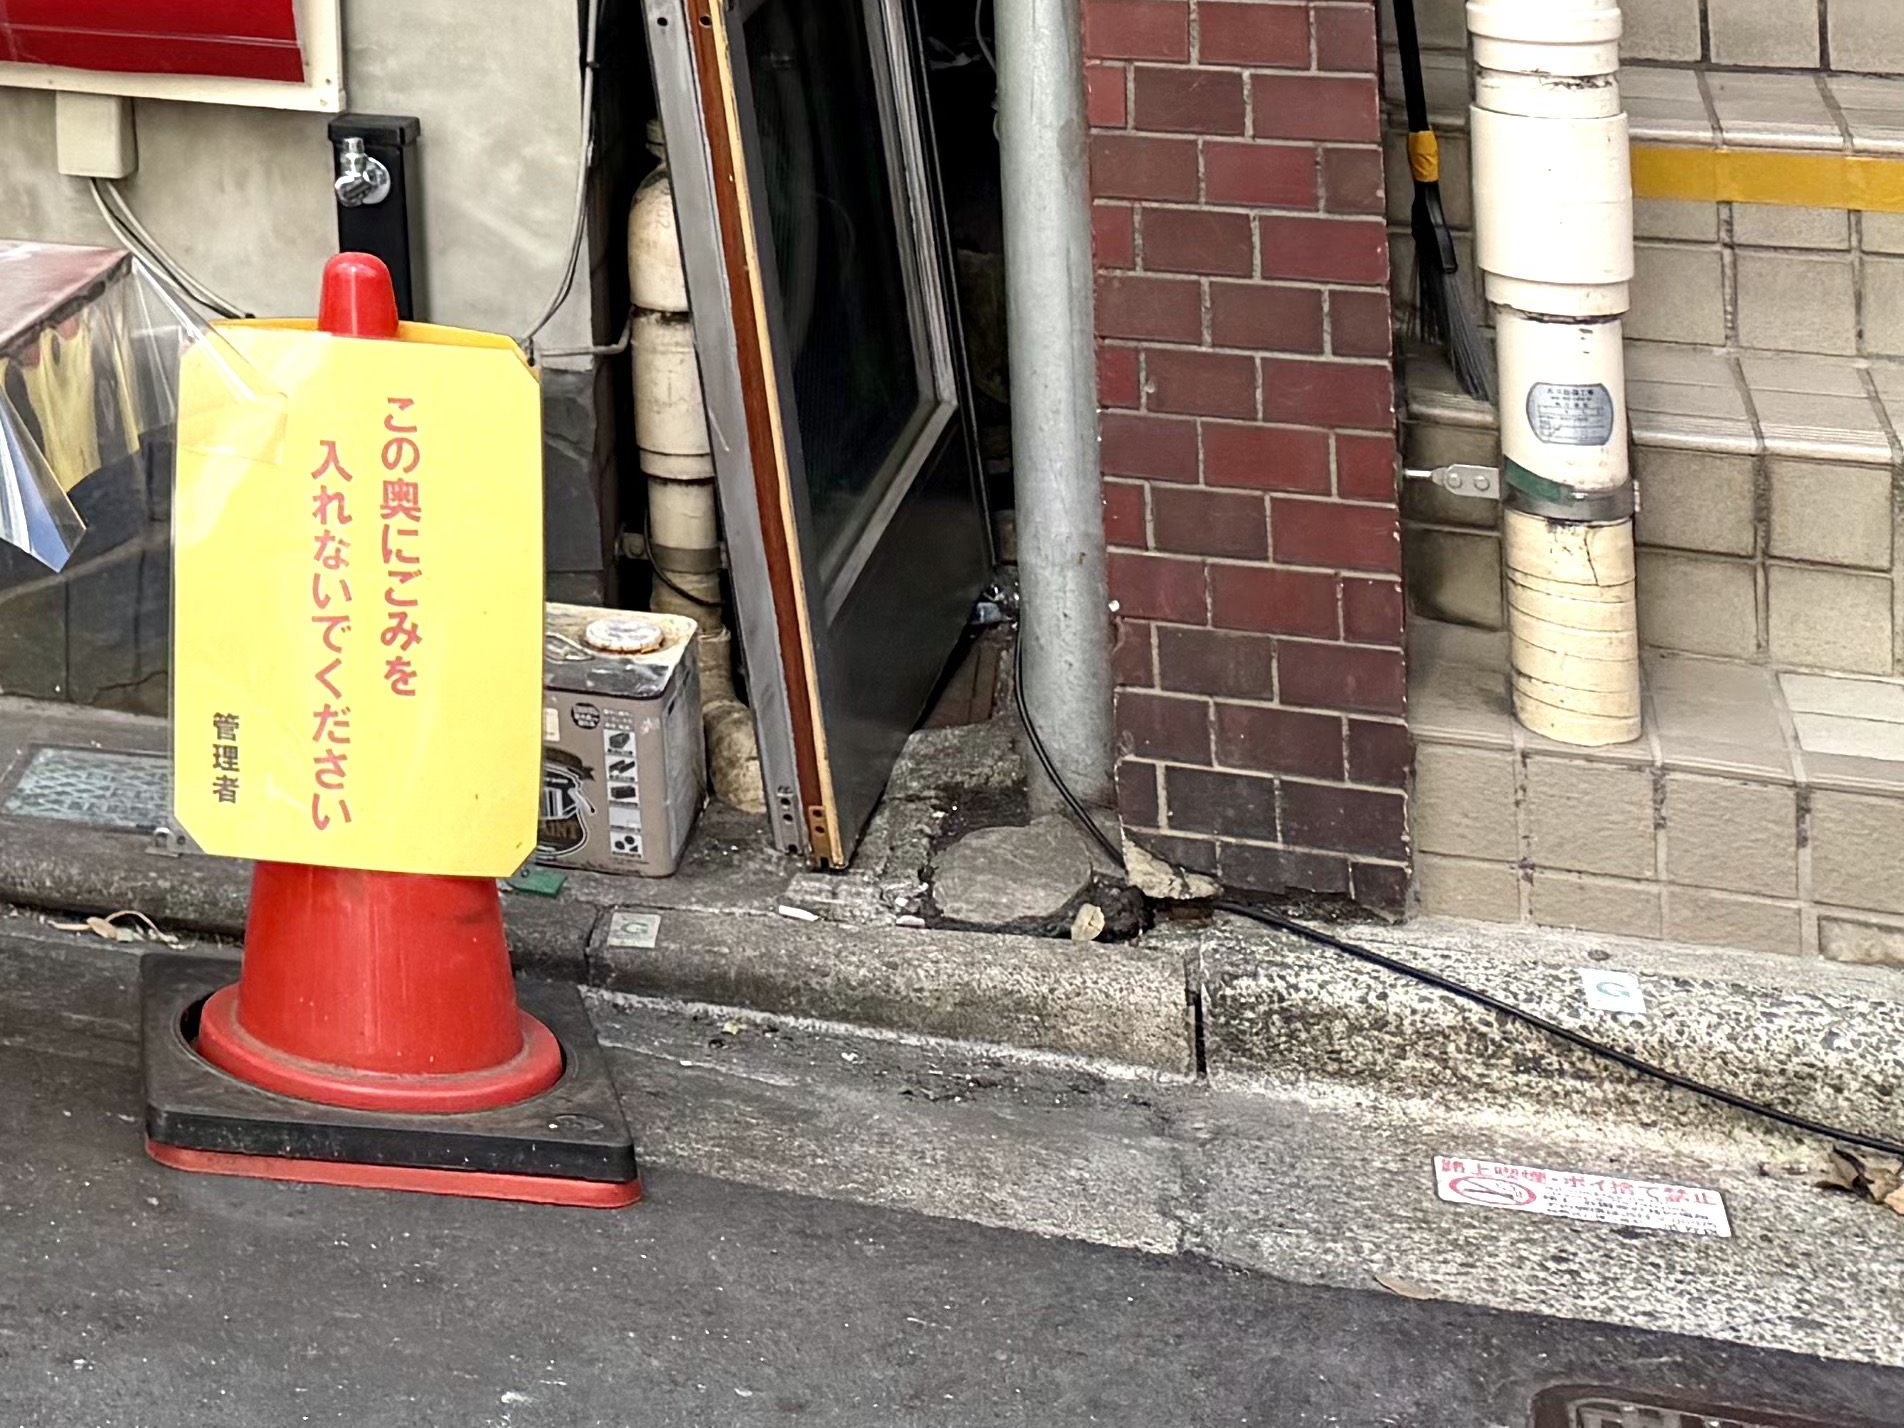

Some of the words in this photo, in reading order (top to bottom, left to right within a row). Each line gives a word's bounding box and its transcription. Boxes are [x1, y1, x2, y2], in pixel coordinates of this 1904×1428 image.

[308, 439, 354, 832] 入れないでください
[378, 396, 424, 697] この奥にごみを
[210, 711, 242, 805] 管理者
